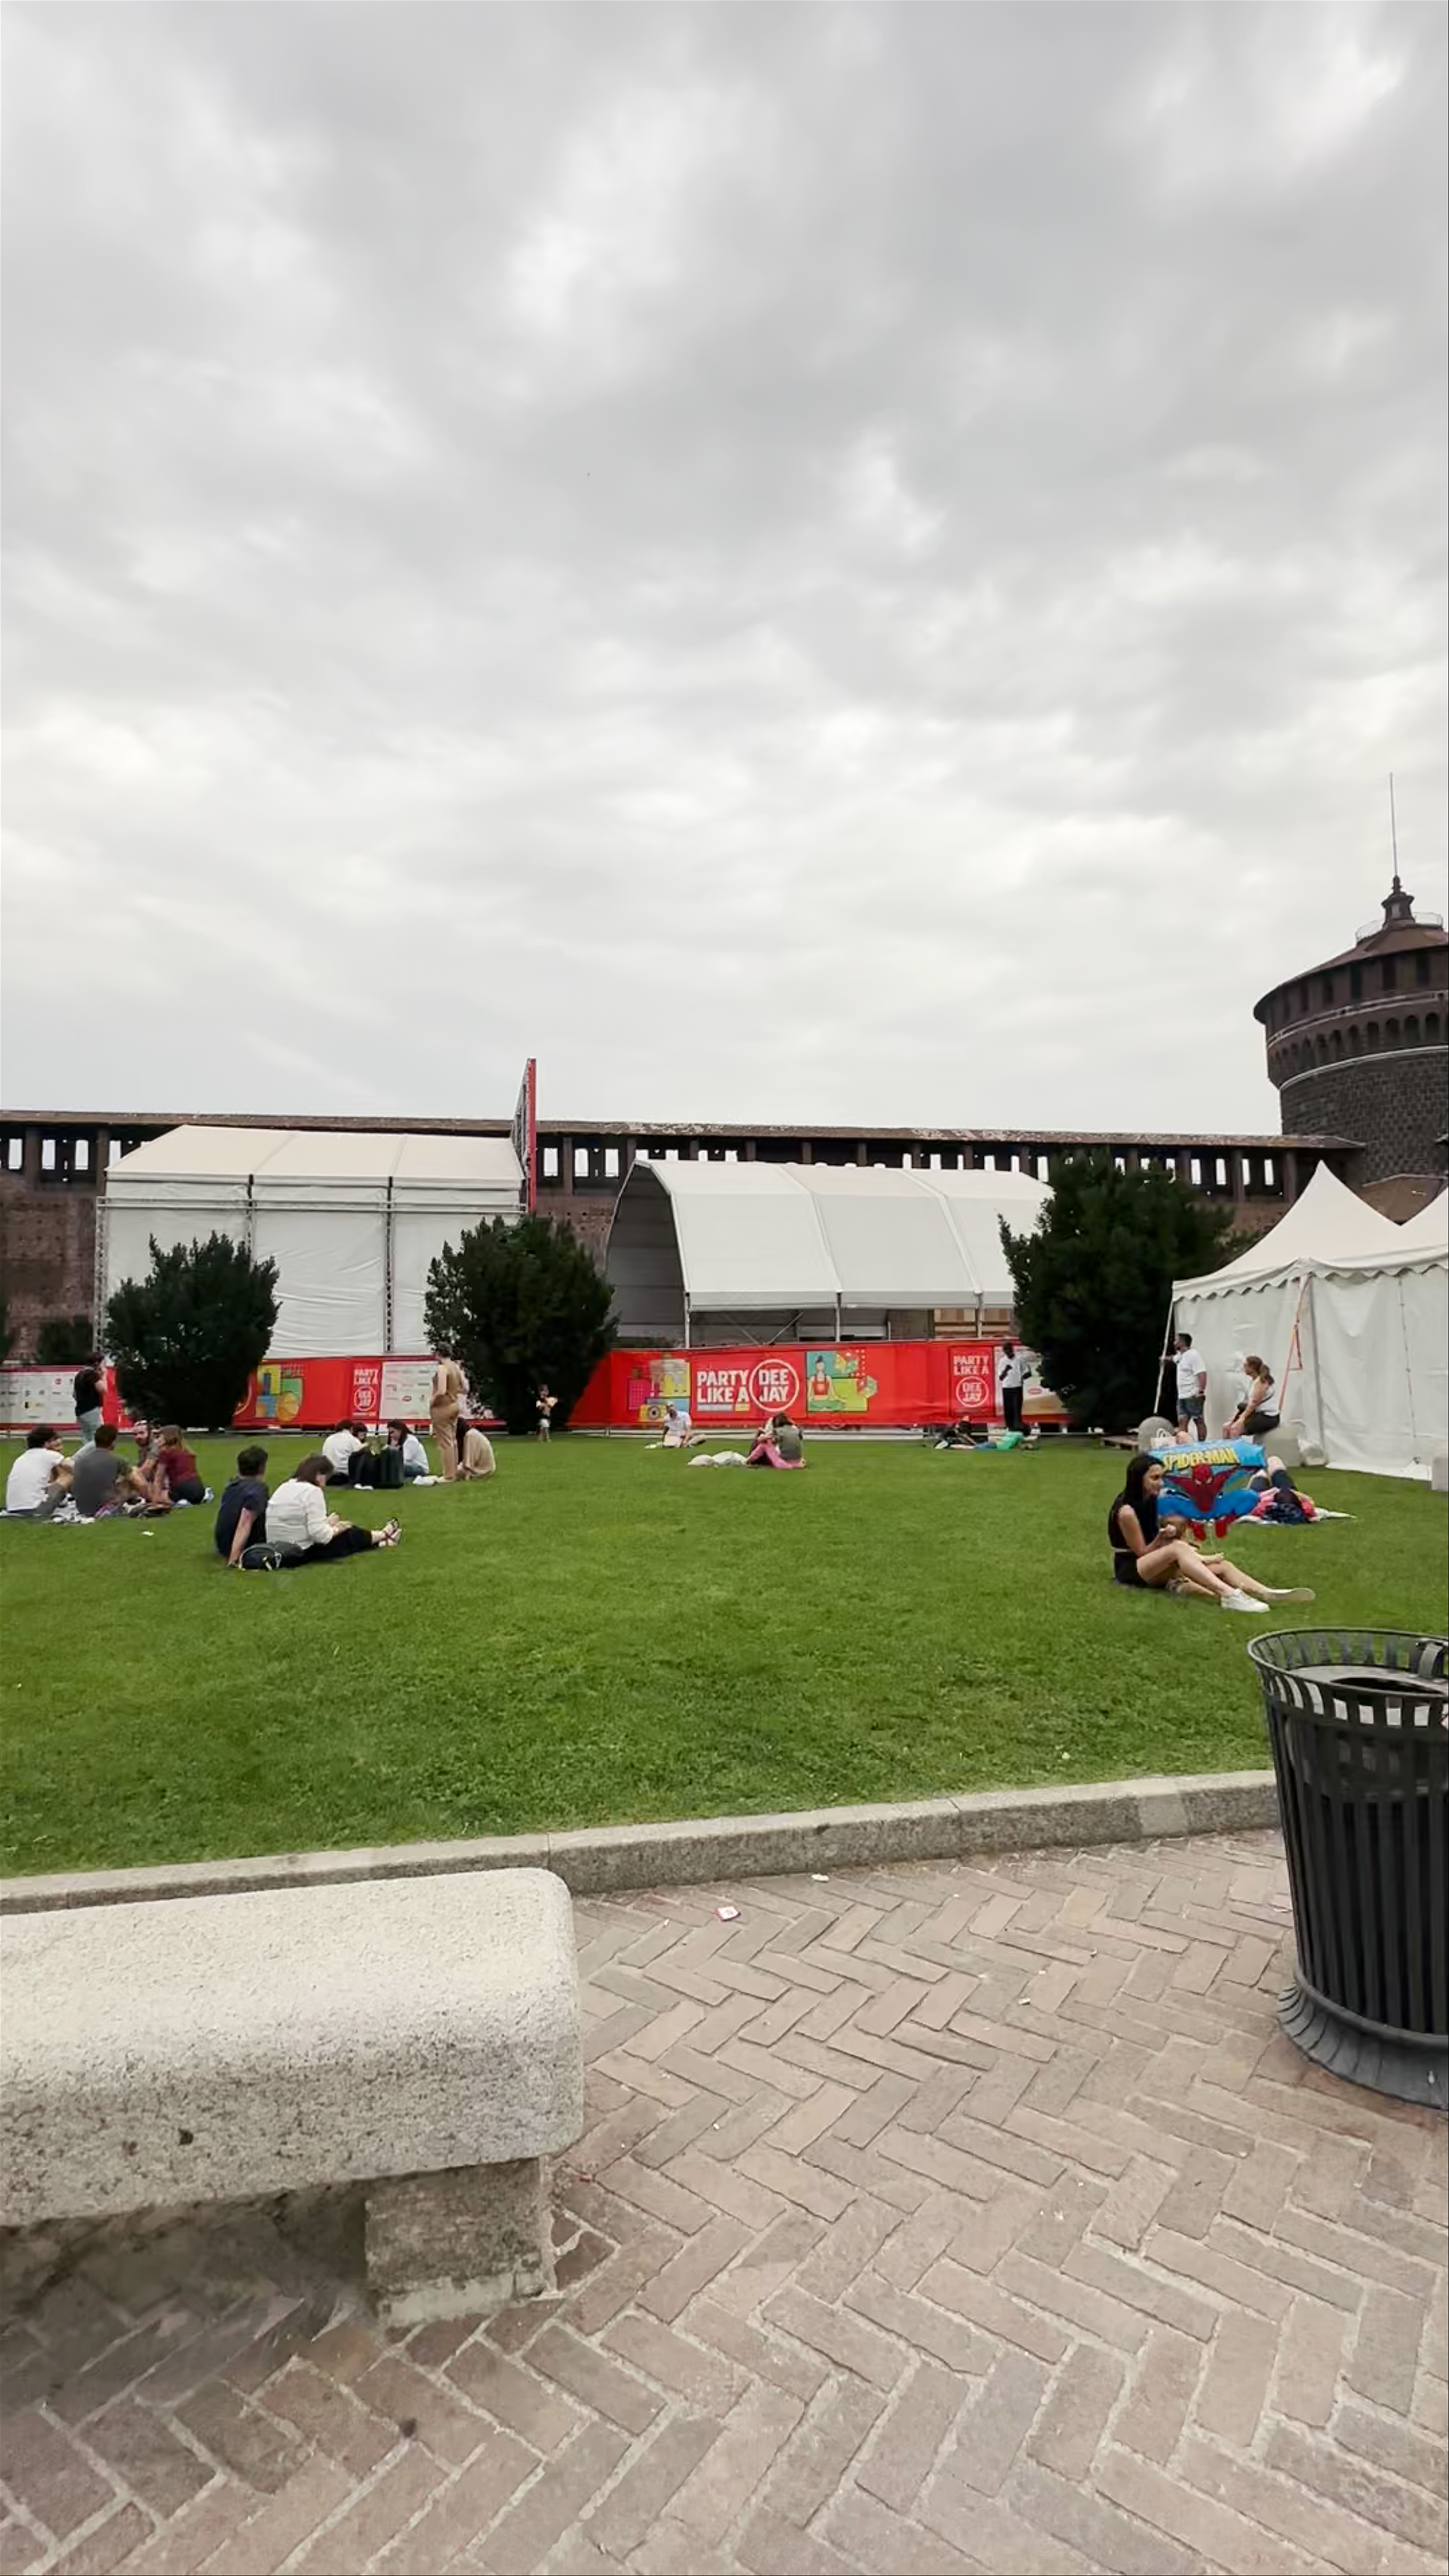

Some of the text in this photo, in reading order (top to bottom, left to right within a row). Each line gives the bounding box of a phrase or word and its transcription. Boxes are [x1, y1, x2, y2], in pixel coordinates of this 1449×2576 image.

[953, 1355, 989, 1365] PARTY
[953, 1365, 989, 1375] LIKE A
[354, 1376, 370, 1385] LIKE
[697, 1370, 749, 1386] PARTY
[758, 1369, 789, 1385] DEE
[962, 1382, 982, 1392] DEE
[697, 1387, 750, 1403] LIKE A
[759, 1386, 789, 1402] JAY
[963, 1393, 982, 1402] JAY
